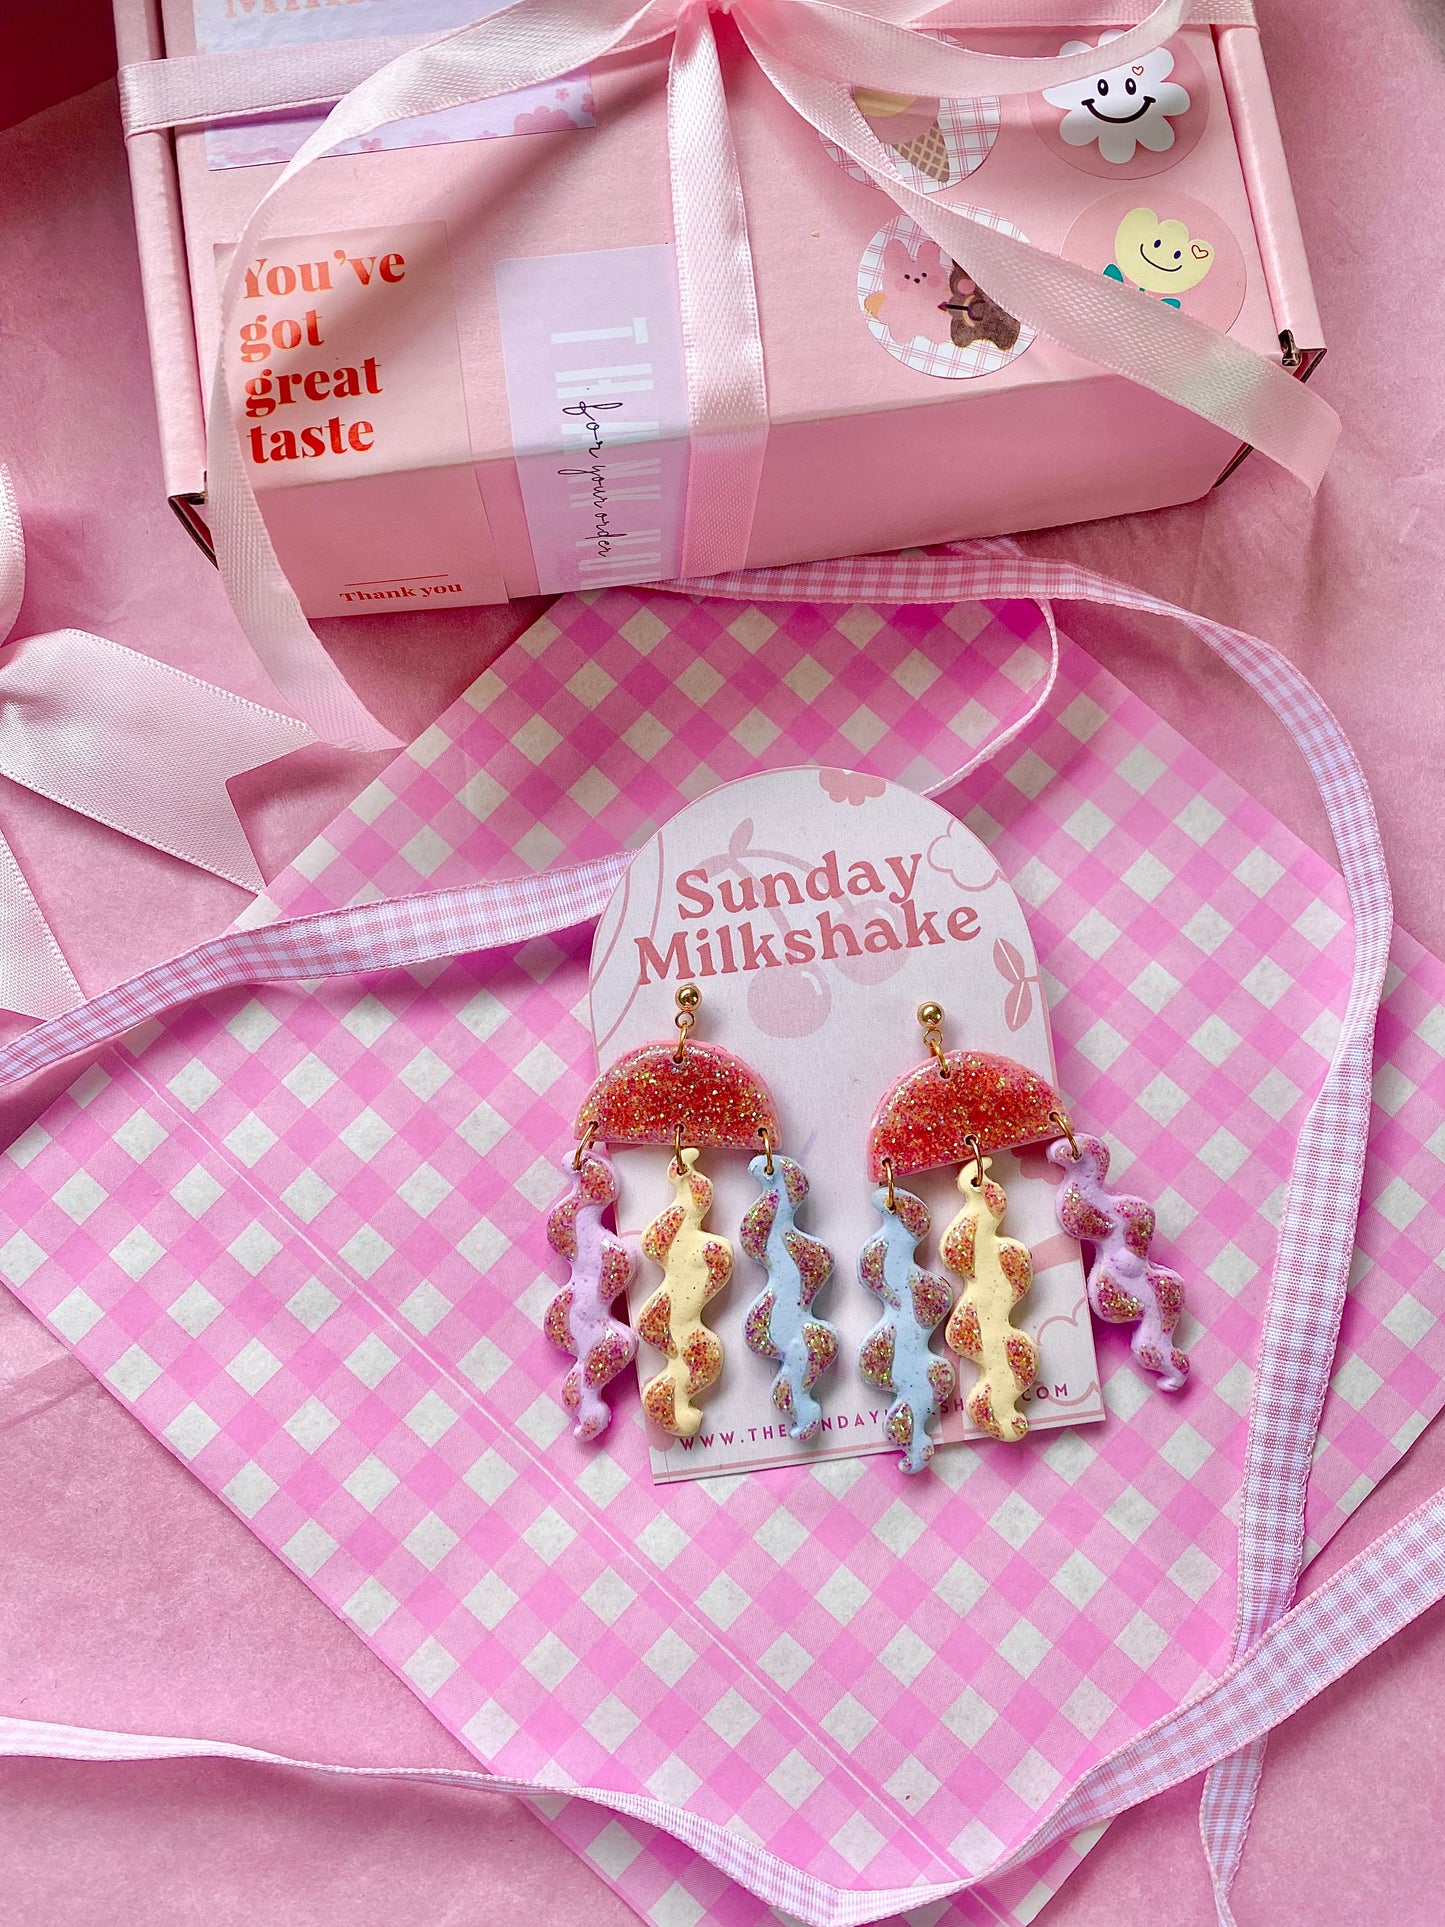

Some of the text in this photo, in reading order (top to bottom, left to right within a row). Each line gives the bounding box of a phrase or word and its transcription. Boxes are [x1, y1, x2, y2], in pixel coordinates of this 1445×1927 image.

[243, 249, 406, 299] You've
[240, 309, 325, 362] got
[245, 357, 383, 418] great
[245, 416, 375, 464] taste
[557, 401, 628, 558] for your order
[339, 583, 463, 602] Thank you
[675, 850, 923, 920] Sunday
[633, 899, 982, 986] Milkshake
